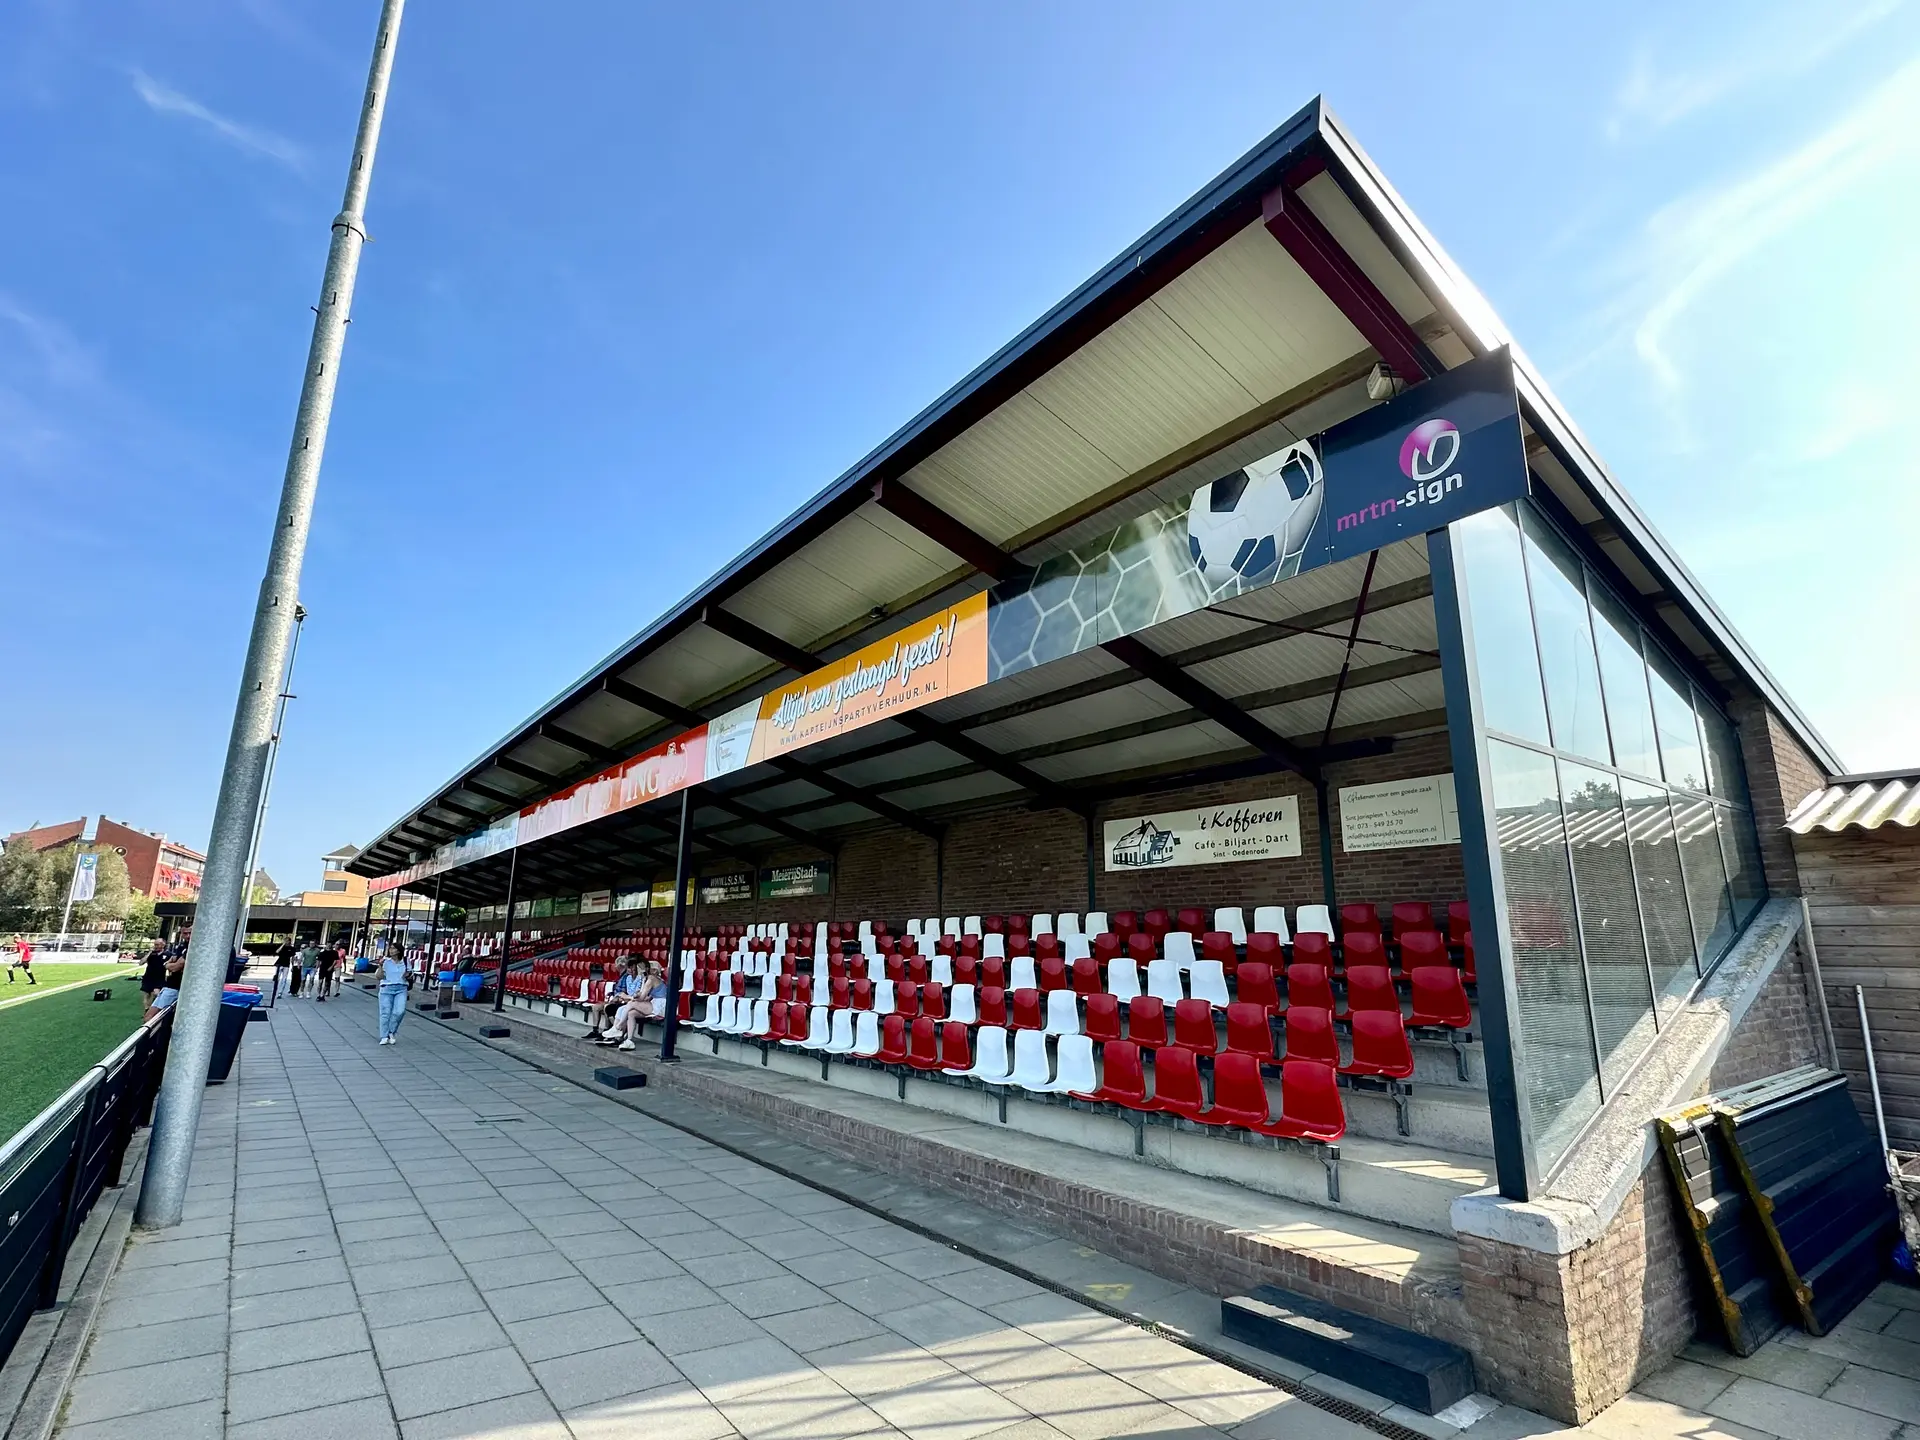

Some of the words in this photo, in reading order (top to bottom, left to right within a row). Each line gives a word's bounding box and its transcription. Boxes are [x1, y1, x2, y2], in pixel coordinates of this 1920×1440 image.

[1336, 472, 1463, 532] mrtn-sign
[772, 685, 809, 733] Altijd
[808, 685, 834, 714] een
[832, 640, 901, 716] geslaagd
[1400, 788, 1418, 796] goede
[1391, 807, 1419, 817] Schijndel
[1210, 808, 1283, 833] Kofferen
[1194, 840, 1216, 850] Café
[1224, 836, 1257, 848] Biljart
[1265, 834, 1289, 843] Dart
[1232, 848, 1269, 857] Oedenrode
